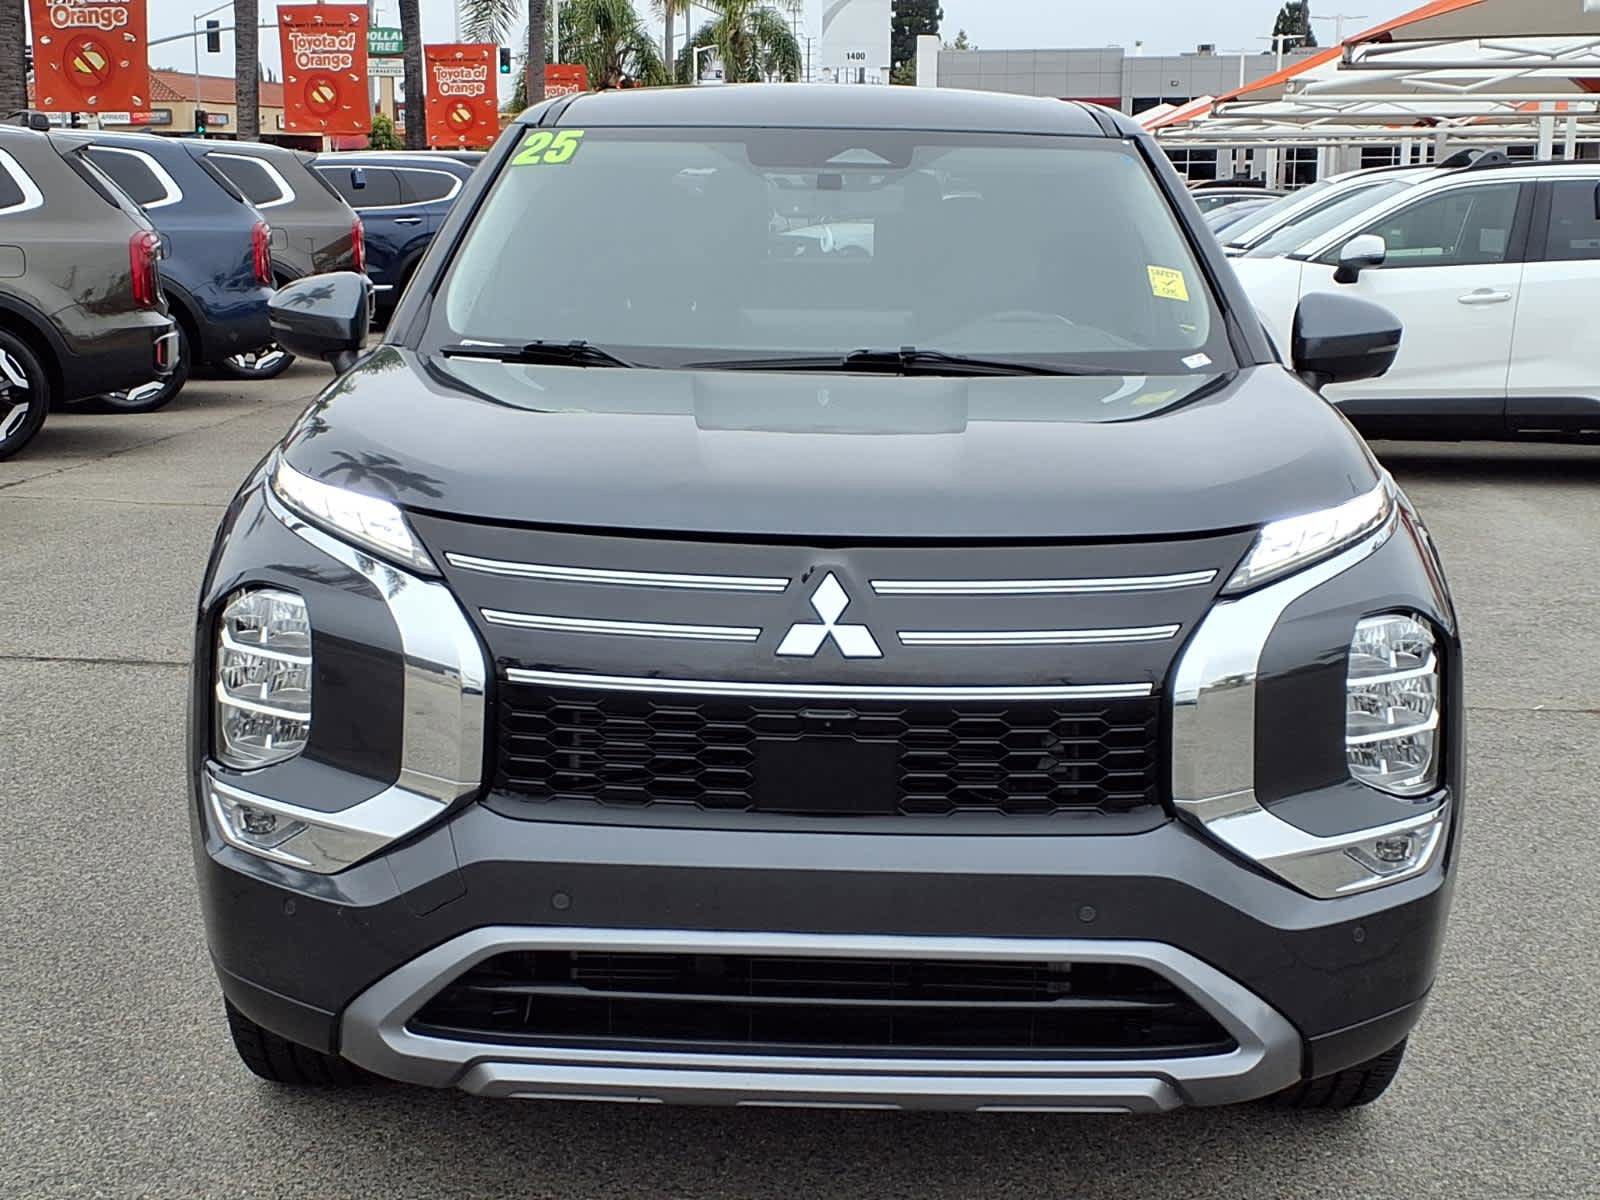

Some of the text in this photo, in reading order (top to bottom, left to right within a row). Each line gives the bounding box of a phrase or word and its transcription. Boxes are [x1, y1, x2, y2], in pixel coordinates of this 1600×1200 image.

[51, 5, 128, 30] Orange
[289, 32, 355, 53] Toyota of
[367, 31, 403, 41] OLLA
[369, 41, 399, 51] TREE
[296, 52, 352, 71] Orange
[847, 52, 865, 60] 1400
[434, 66, 487, 82] Toyota of
[439, 82, 485, 96] Orange
[511, 130, 585, 165] 25
